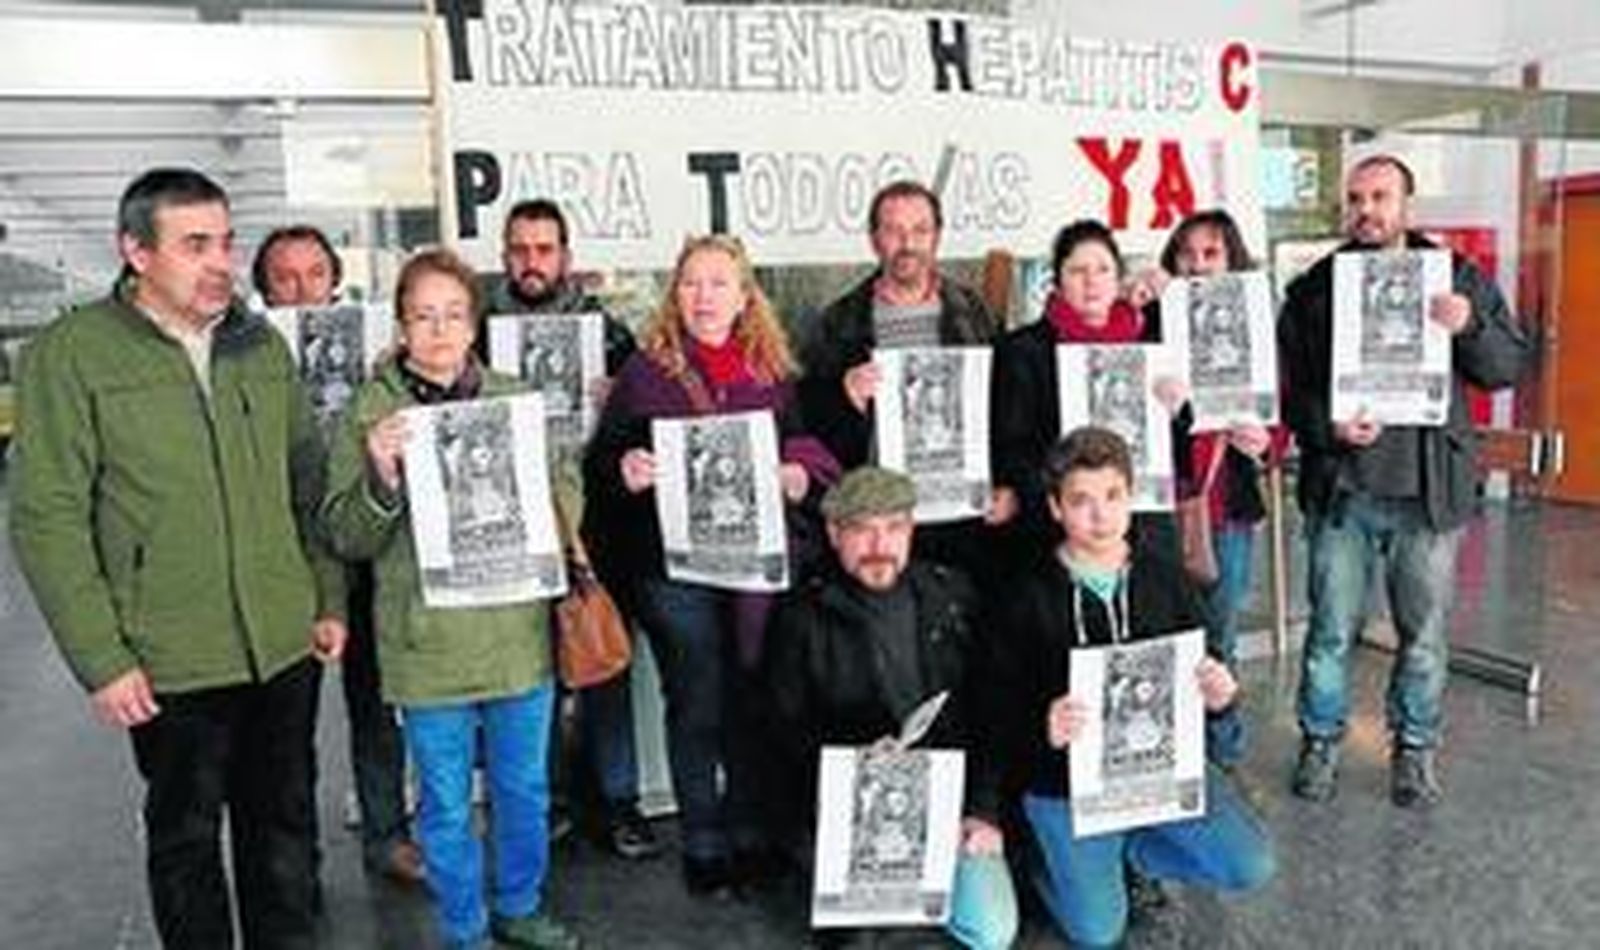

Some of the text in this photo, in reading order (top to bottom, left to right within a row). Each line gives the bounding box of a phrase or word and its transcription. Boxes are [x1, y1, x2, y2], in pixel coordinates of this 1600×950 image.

[435, 0, 1251, 113] TRATAMIENTO HEPATITIS C
